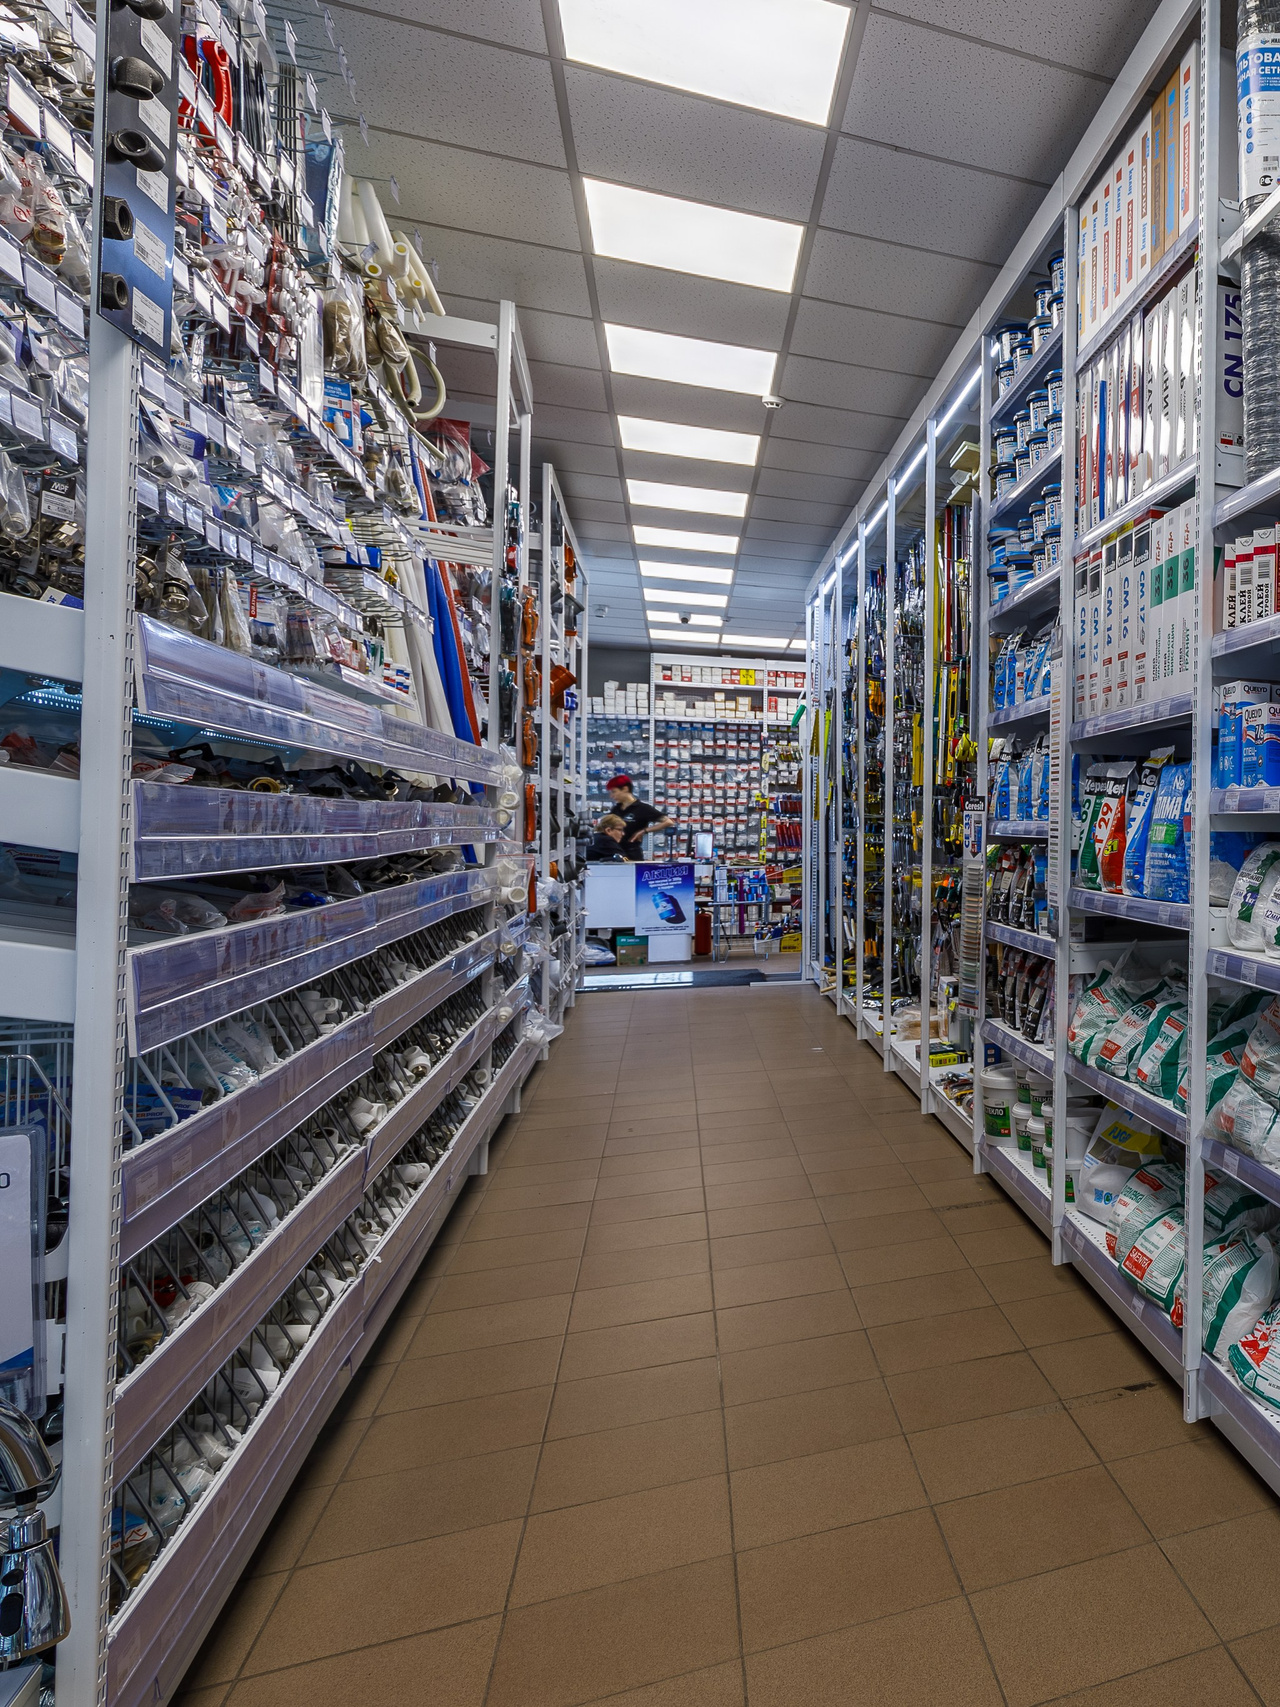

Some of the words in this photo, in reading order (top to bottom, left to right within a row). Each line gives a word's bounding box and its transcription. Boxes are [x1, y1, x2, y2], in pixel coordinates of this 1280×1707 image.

[1226, 595, 1236, 628] КЛЕЙ
[1238, 590, 1247, 624] КЛЕЙ
[1256, 584, 1264, 618] КЛЕЙ
[1243, 684, 1268, 696] QUELYD
[642, 865, 689, 882] АКЦИЯ
